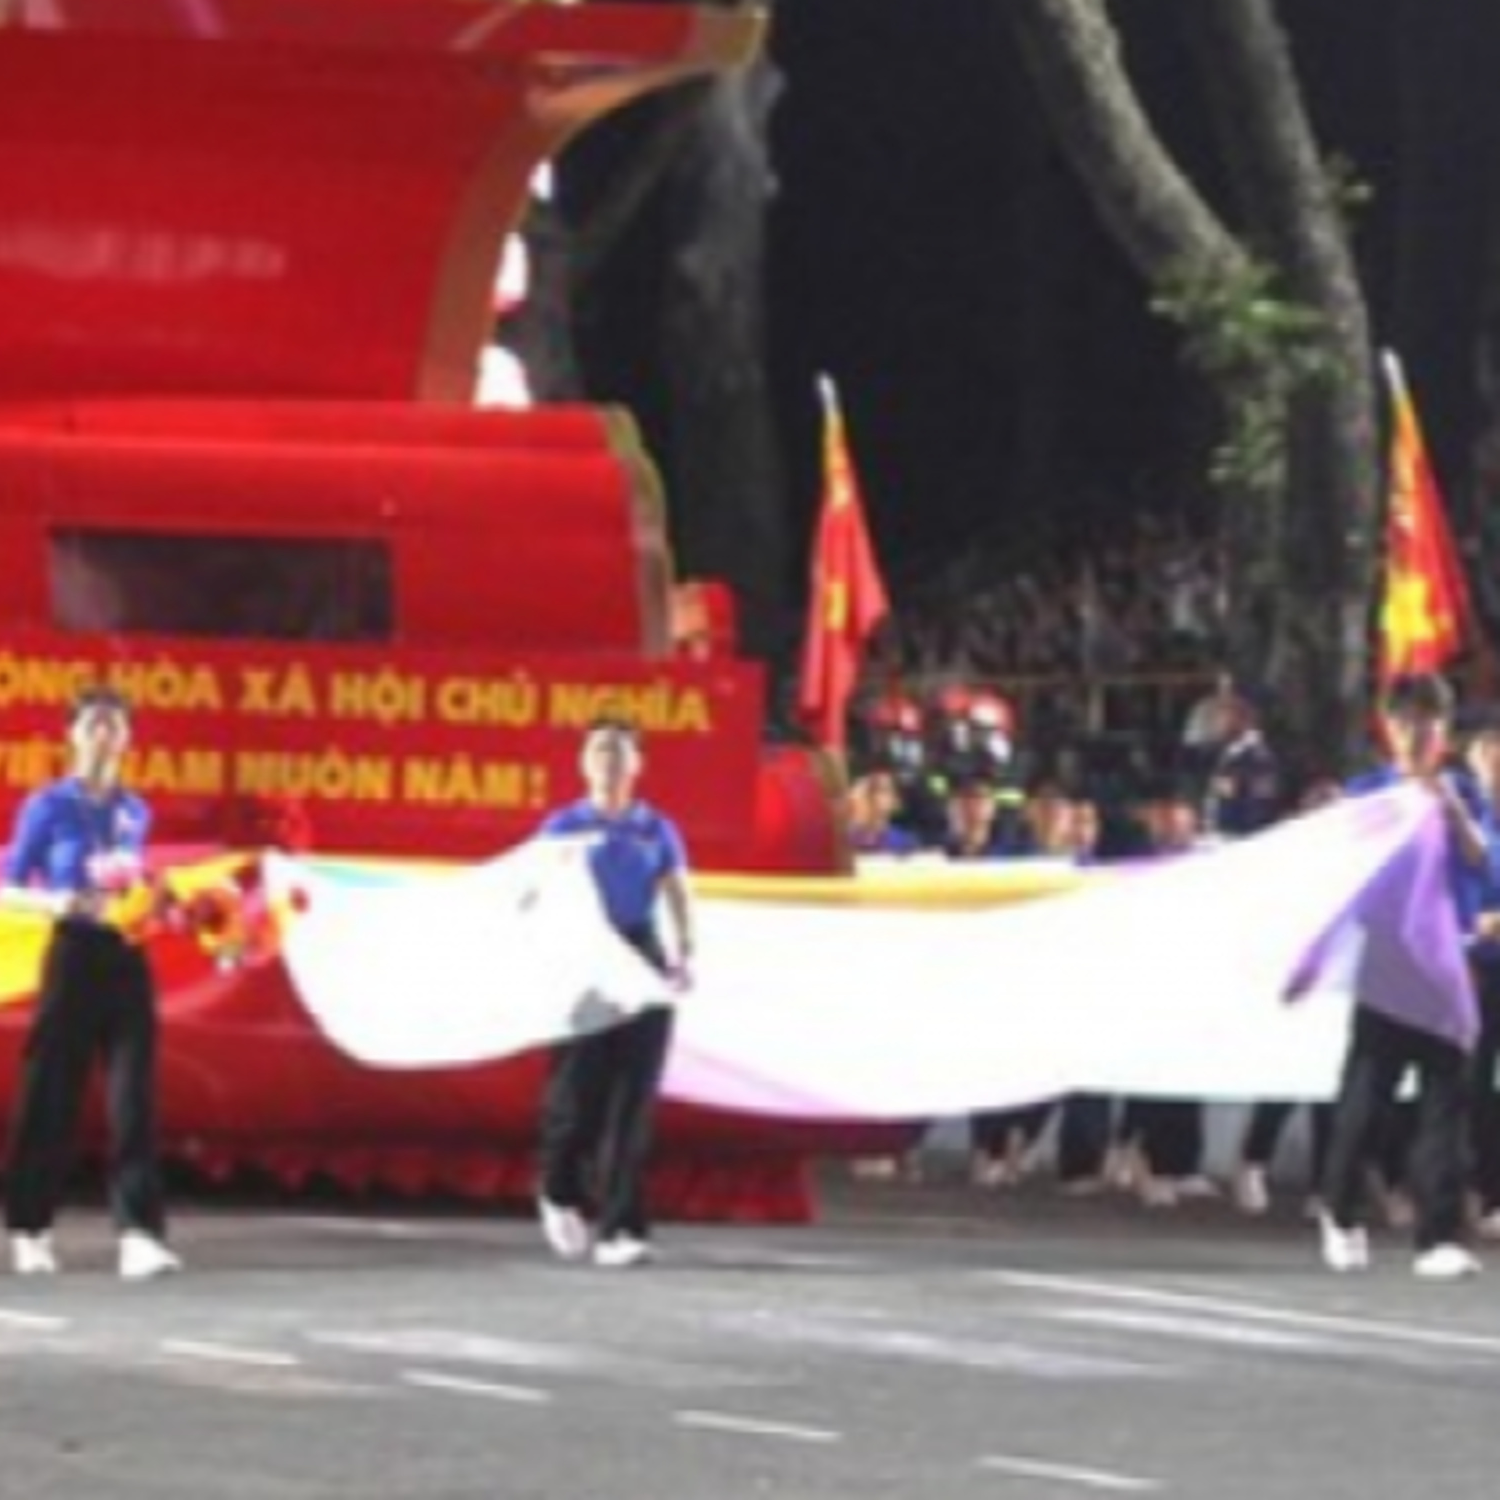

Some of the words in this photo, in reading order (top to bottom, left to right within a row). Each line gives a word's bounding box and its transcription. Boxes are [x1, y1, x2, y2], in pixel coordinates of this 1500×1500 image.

[108, 651, 222, 709] HÒA
[241, 658, 316, 715] XÃ
[331, 668, 423, 725] HỘI
[436, 668, 538, 727] CHỦ
[235, 748, 393, 799] MUÔN
